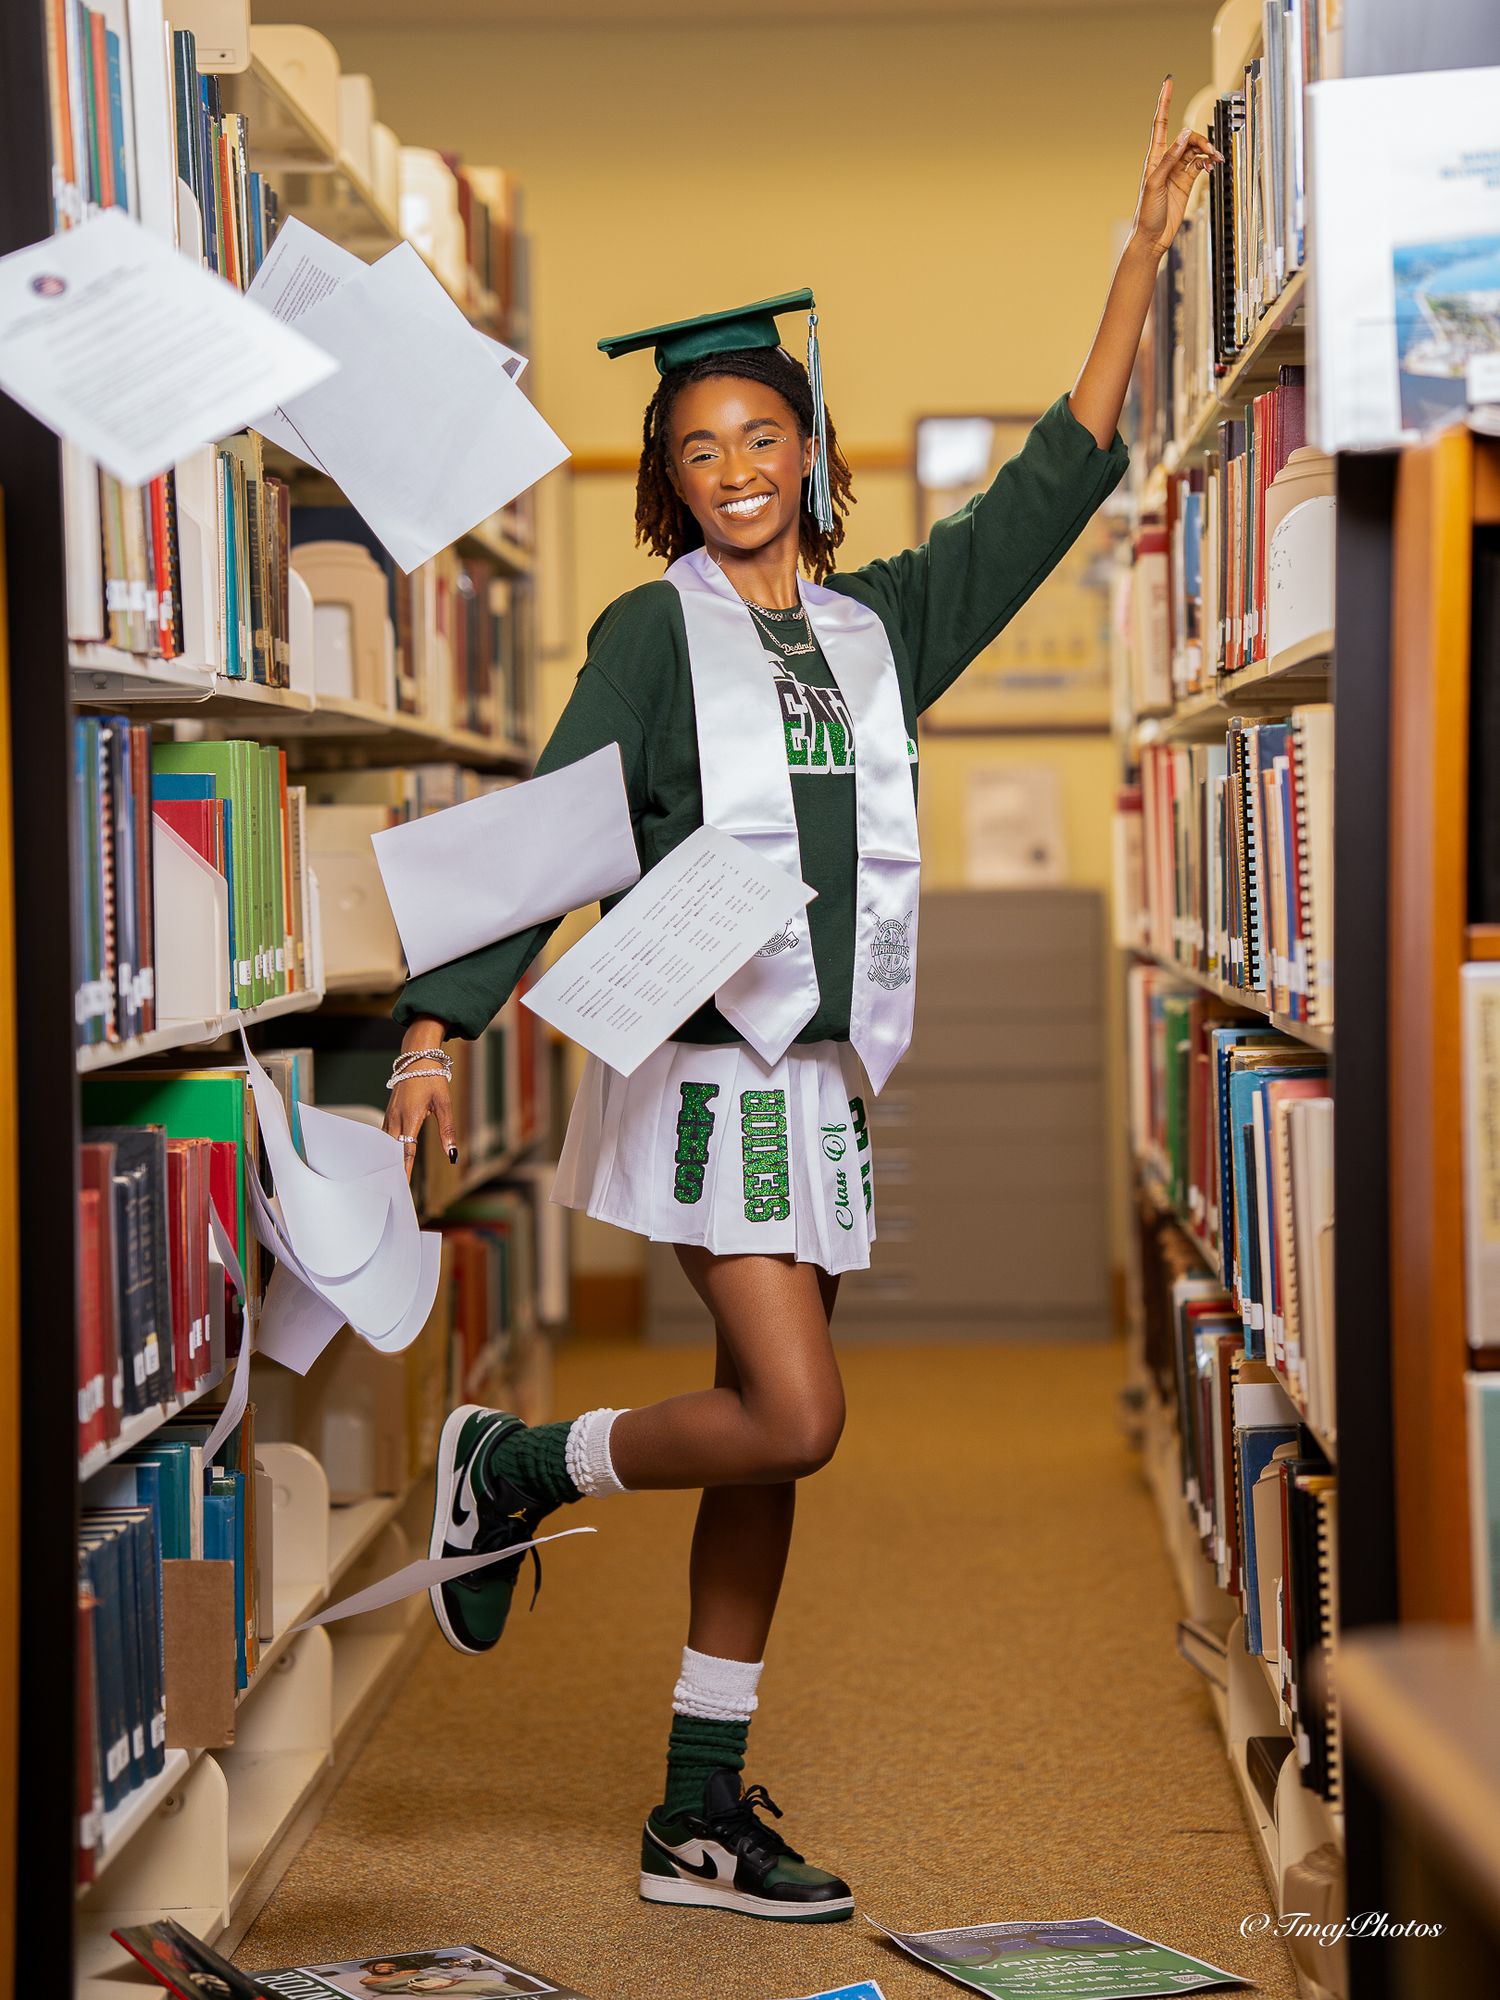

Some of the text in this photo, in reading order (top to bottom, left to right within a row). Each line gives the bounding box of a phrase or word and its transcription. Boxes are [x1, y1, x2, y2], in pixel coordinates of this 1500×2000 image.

[871, 943, 910, 961] WARRIORS
[676, 1082, 720, 1204] KHS
[739, 1089, 791, 1223] SENIOR
[820, 1122, 855, 1232] Class Of
[965, 1952, 1120, 1971] WRINKLE
[1125, 1948, 1159, 1956] IN
[1018, 1960, 1099, 1971] TIME
[1123, 1969, 1196, 1980] 2024
